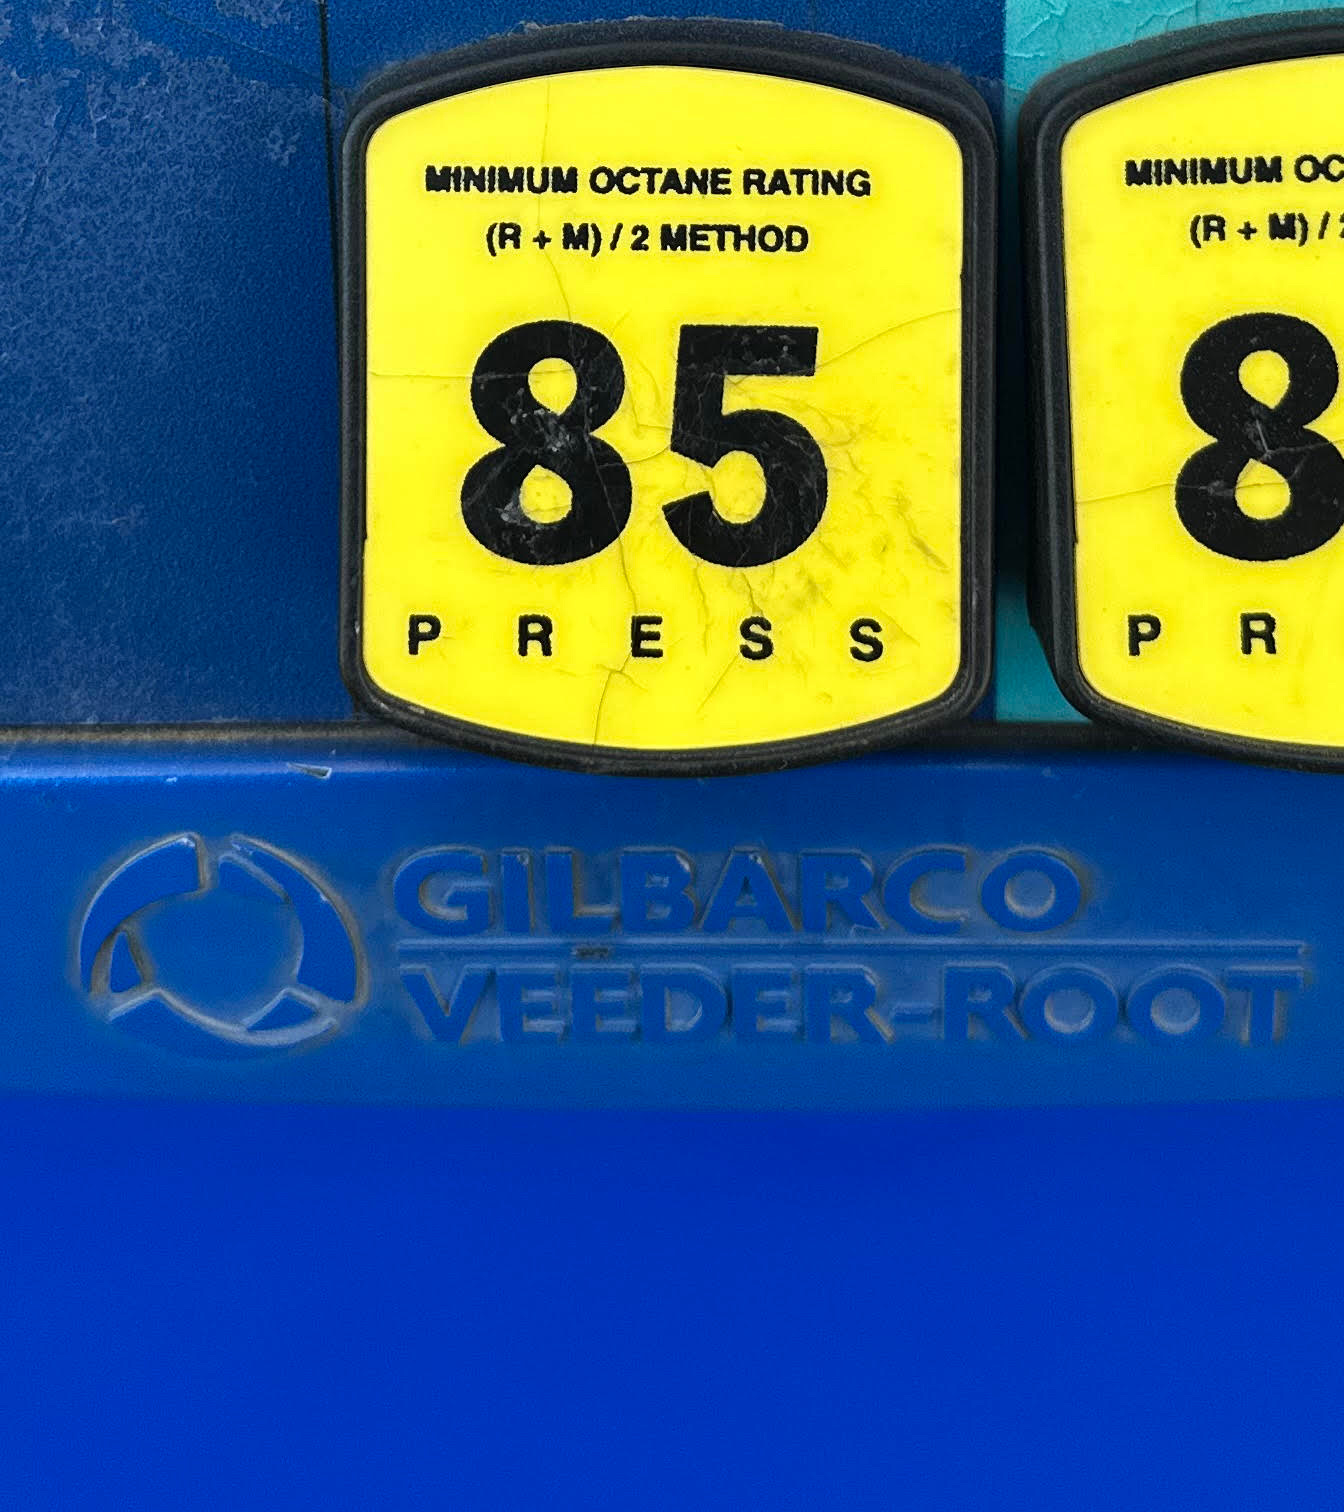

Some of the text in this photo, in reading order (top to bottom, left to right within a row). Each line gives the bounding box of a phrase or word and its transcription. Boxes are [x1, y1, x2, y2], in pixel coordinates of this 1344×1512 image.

[425, 165, 872, 197] MINIMUM OCTANE RATING
[1125, 155, 1283, 187] MINIMUM
[631, 224, 649, 251] 2
[660, 224, 809, 253] METHOD
[460, 319, 829, 568] 85
[392, 844, 1088, 937] GILBARCO
[399, 961, 1307, 1046] VEEDER-ROOT
